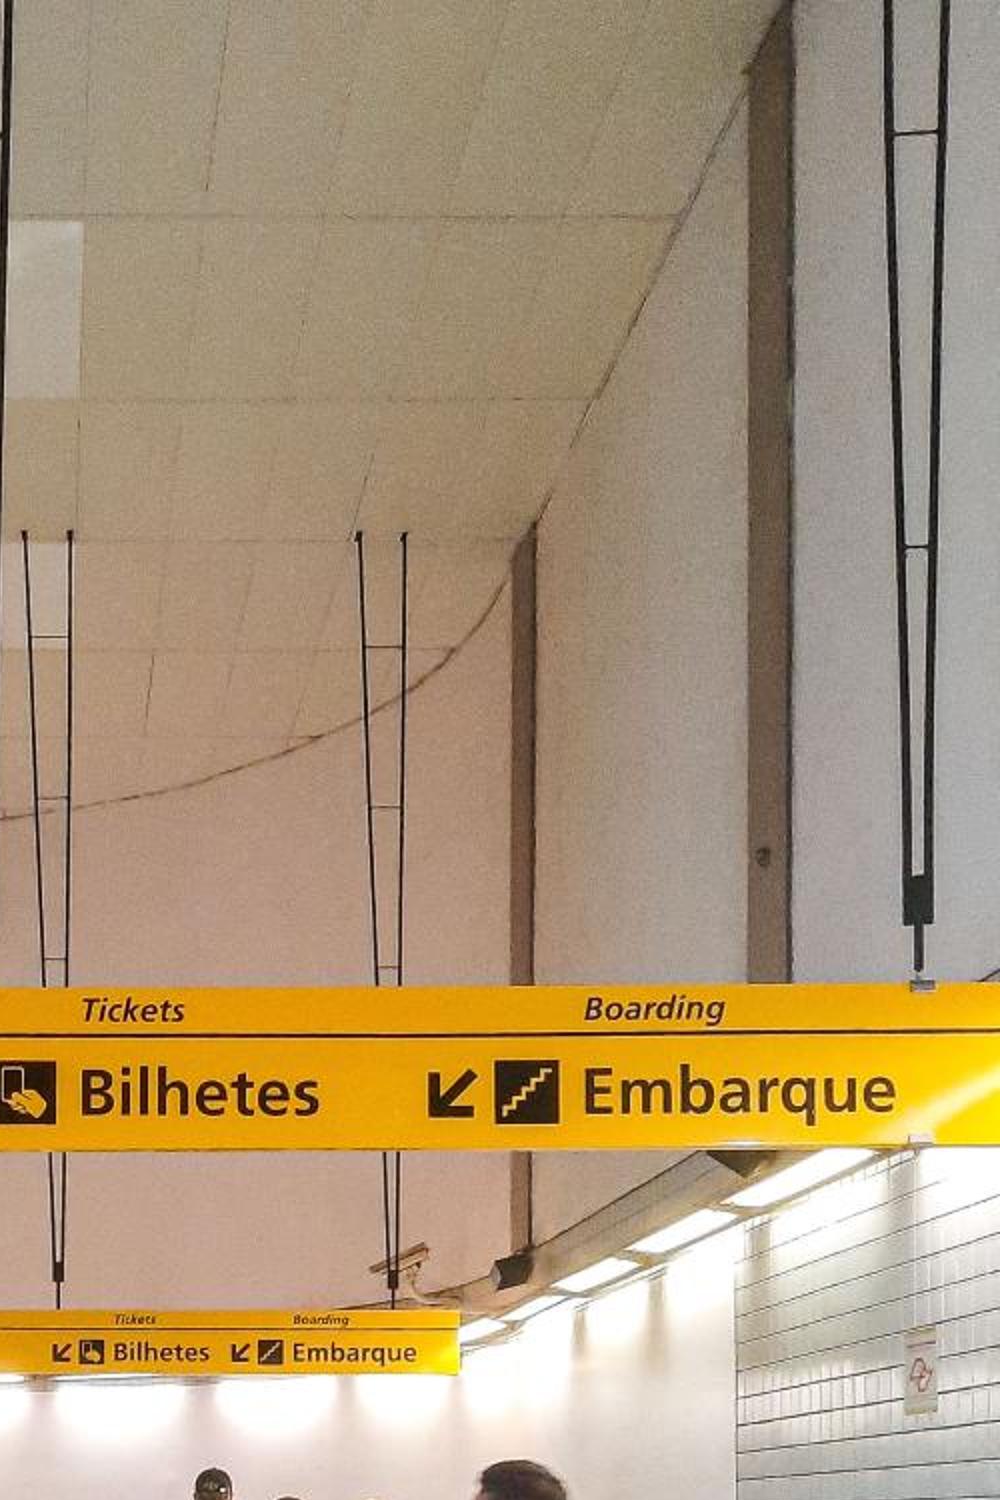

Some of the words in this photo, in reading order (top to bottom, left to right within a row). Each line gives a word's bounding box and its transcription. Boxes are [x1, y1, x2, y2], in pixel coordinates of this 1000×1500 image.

[81, 996, 185, 1023] Tickets
[583, 993, 726, 1026] Boarding
[81, 1065, 320, 1117] Bilhetes
[584, 1063, 896, 1127] Embarque
[114, 1313, 156, 1325] Tickets
[292, 1313, 350, 1327] Boarding
[113, 1341, 210, 1362] Bilhetes
[292, 1341, 418, 1366] Embarque
